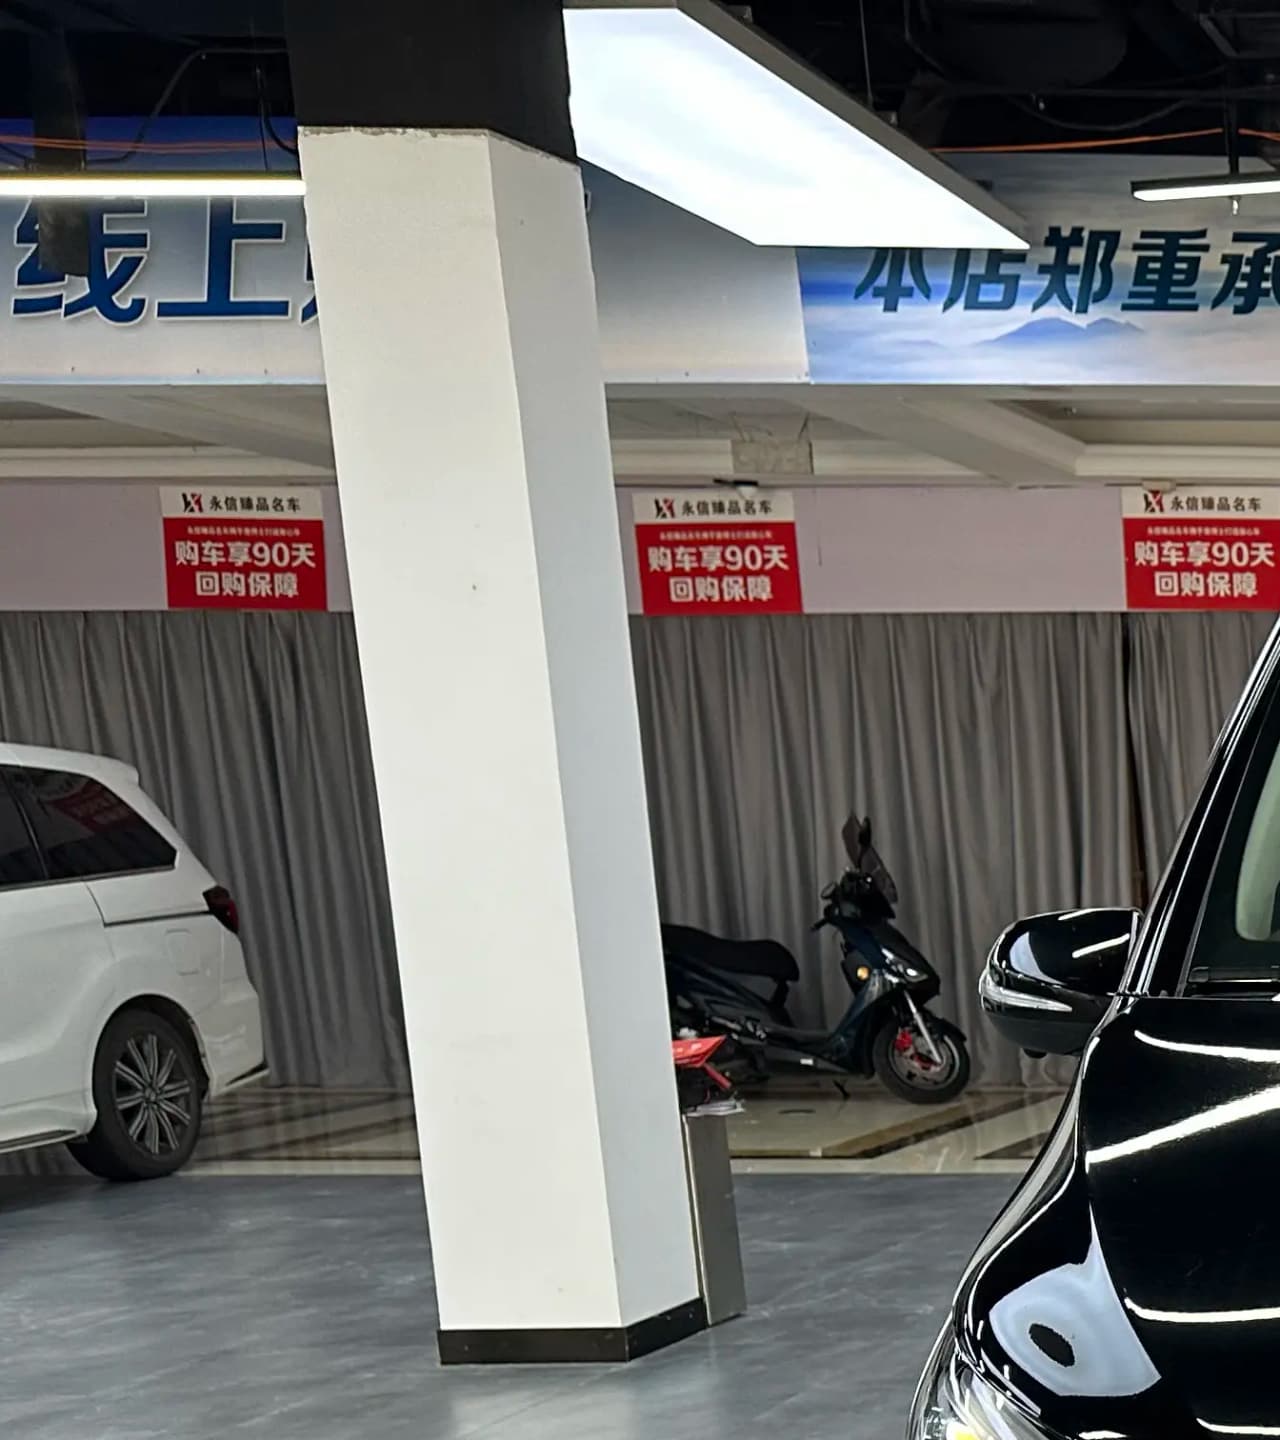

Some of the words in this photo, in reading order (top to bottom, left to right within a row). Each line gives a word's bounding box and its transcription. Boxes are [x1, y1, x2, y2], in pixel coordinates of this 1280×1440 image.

[11, 197, 318, 325] 线上
[210, 496, 301, 512] 永信臻品名车
[1171, 496, 1262, 512] 永信臻品名车
[175, 540, 316, 568] 购车享90天
[648, 545, 789, 573] 购车享90天
[1134, 540, 1275, 568] 购车享90天
[195, 571, 299, 598] 回购保障
[669, 575, 773, 602] 回购保障
[1154, 571, 1258, 598] 回购保障
